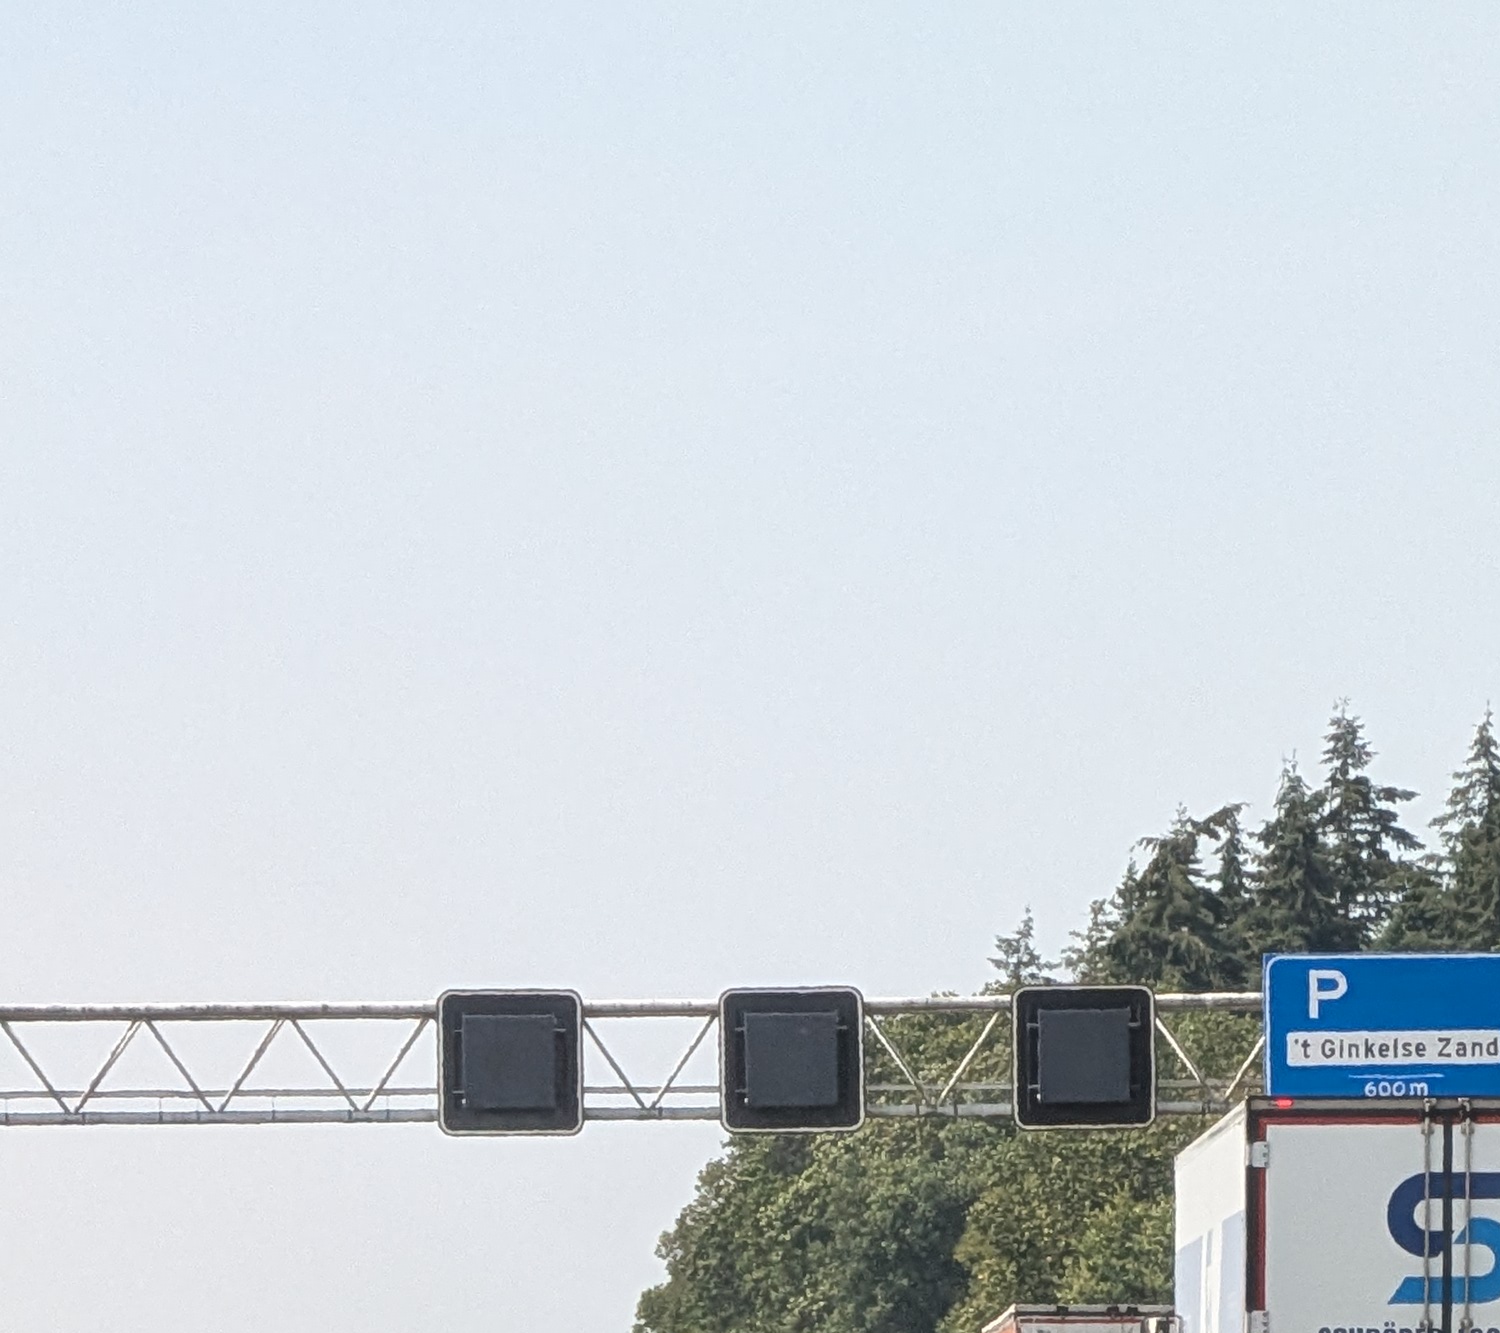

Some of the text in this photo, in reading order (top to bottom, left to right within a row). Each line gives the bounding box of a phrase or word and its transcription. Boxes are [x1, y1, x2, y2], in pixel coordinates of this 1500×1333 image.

[1308, 969, 1348, 1019] P
[1321, 1038, 1427, 1059] Ginkelse
[1437, 1037, 1499, 1058] Zand
